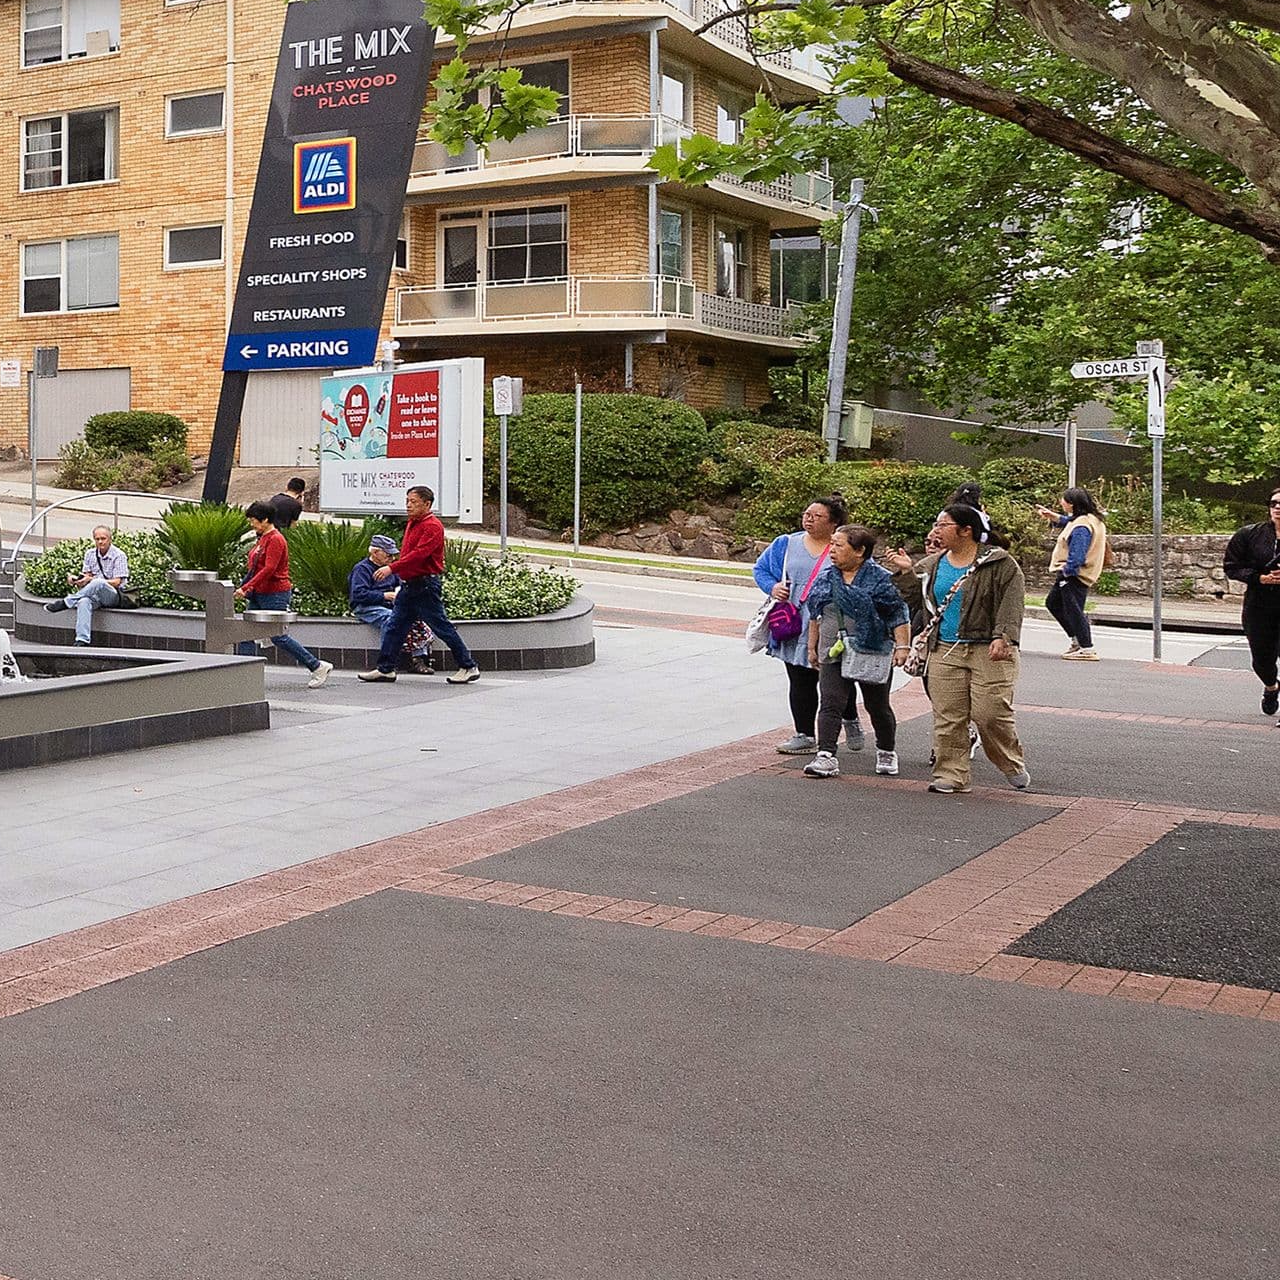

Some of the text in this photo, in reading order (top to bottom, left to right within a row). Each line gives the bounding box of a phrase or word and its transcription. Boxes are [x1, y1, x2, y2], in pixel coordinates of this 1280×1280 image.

[288, 25, 412, 69] THE MIX
[292, 73, 397, 97] CHATSWOOD
[318, 92, 370, 109] PLACE
[304, 182, 345, 198] ALDI
[269, 231, 354, 249] FRESH FOOD
[247, 268, 367, 287] SPECIALITY SHOPS
[253, 306, 345, 322] RESTAURANTS
[267, 340, 349, 358] PARKING
[1086, 361, 1148, 375] OSCAR ST
[396, 394, 410, 404] Take
[415, 392, 429, 402] book
[430, 393, 437, 401] to
[401, 406, 413, 415] read
[421, 404, 437, 413] leave
[421, 417, 437, 426] share
[391, 431, 406, 439] Inside
[422, 429, 437, 438] Level
[342, 473, 377, 488] THE MIX
[379, 472, 416, 480] CHATSWOOD
